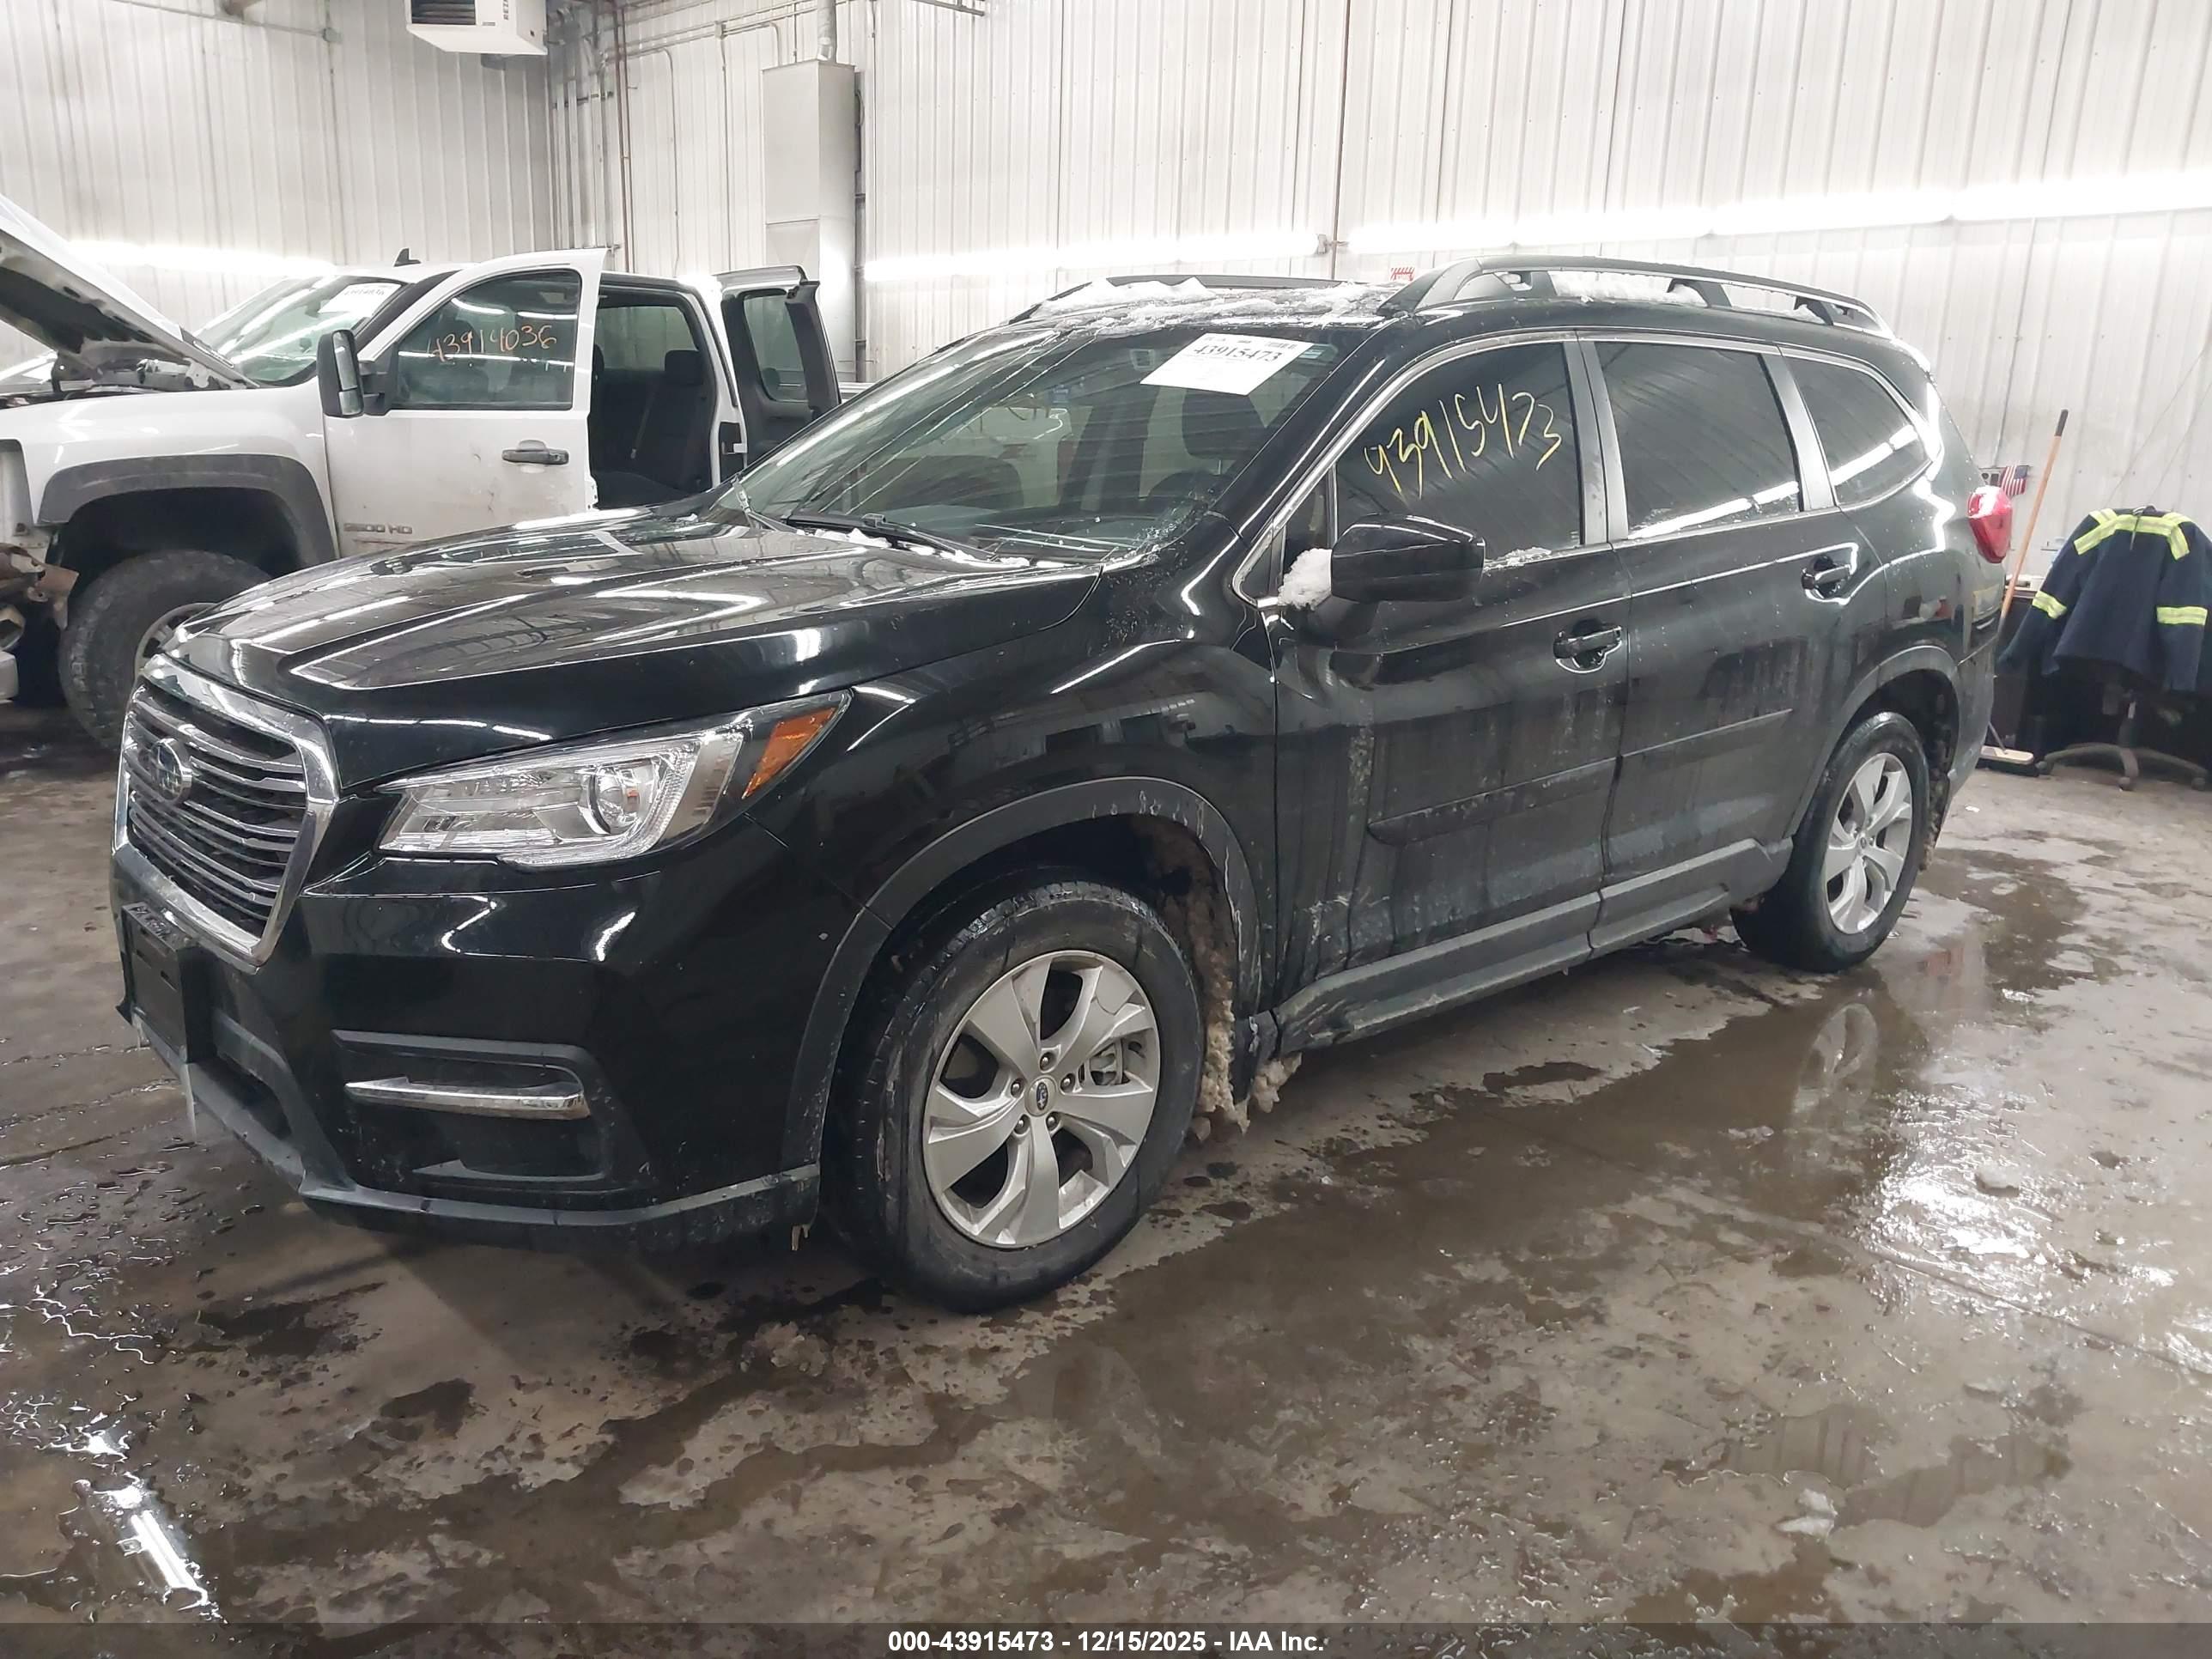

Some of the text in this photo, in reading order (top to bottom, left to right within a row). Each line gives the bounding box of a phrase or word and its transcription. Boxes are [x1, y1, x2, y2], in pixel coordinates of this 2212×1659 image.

[427, 325, 557, 362] 43914036
[1194, 344, 1283, 362] 43915473
[1364, 383, 1562, 499] 43915473
